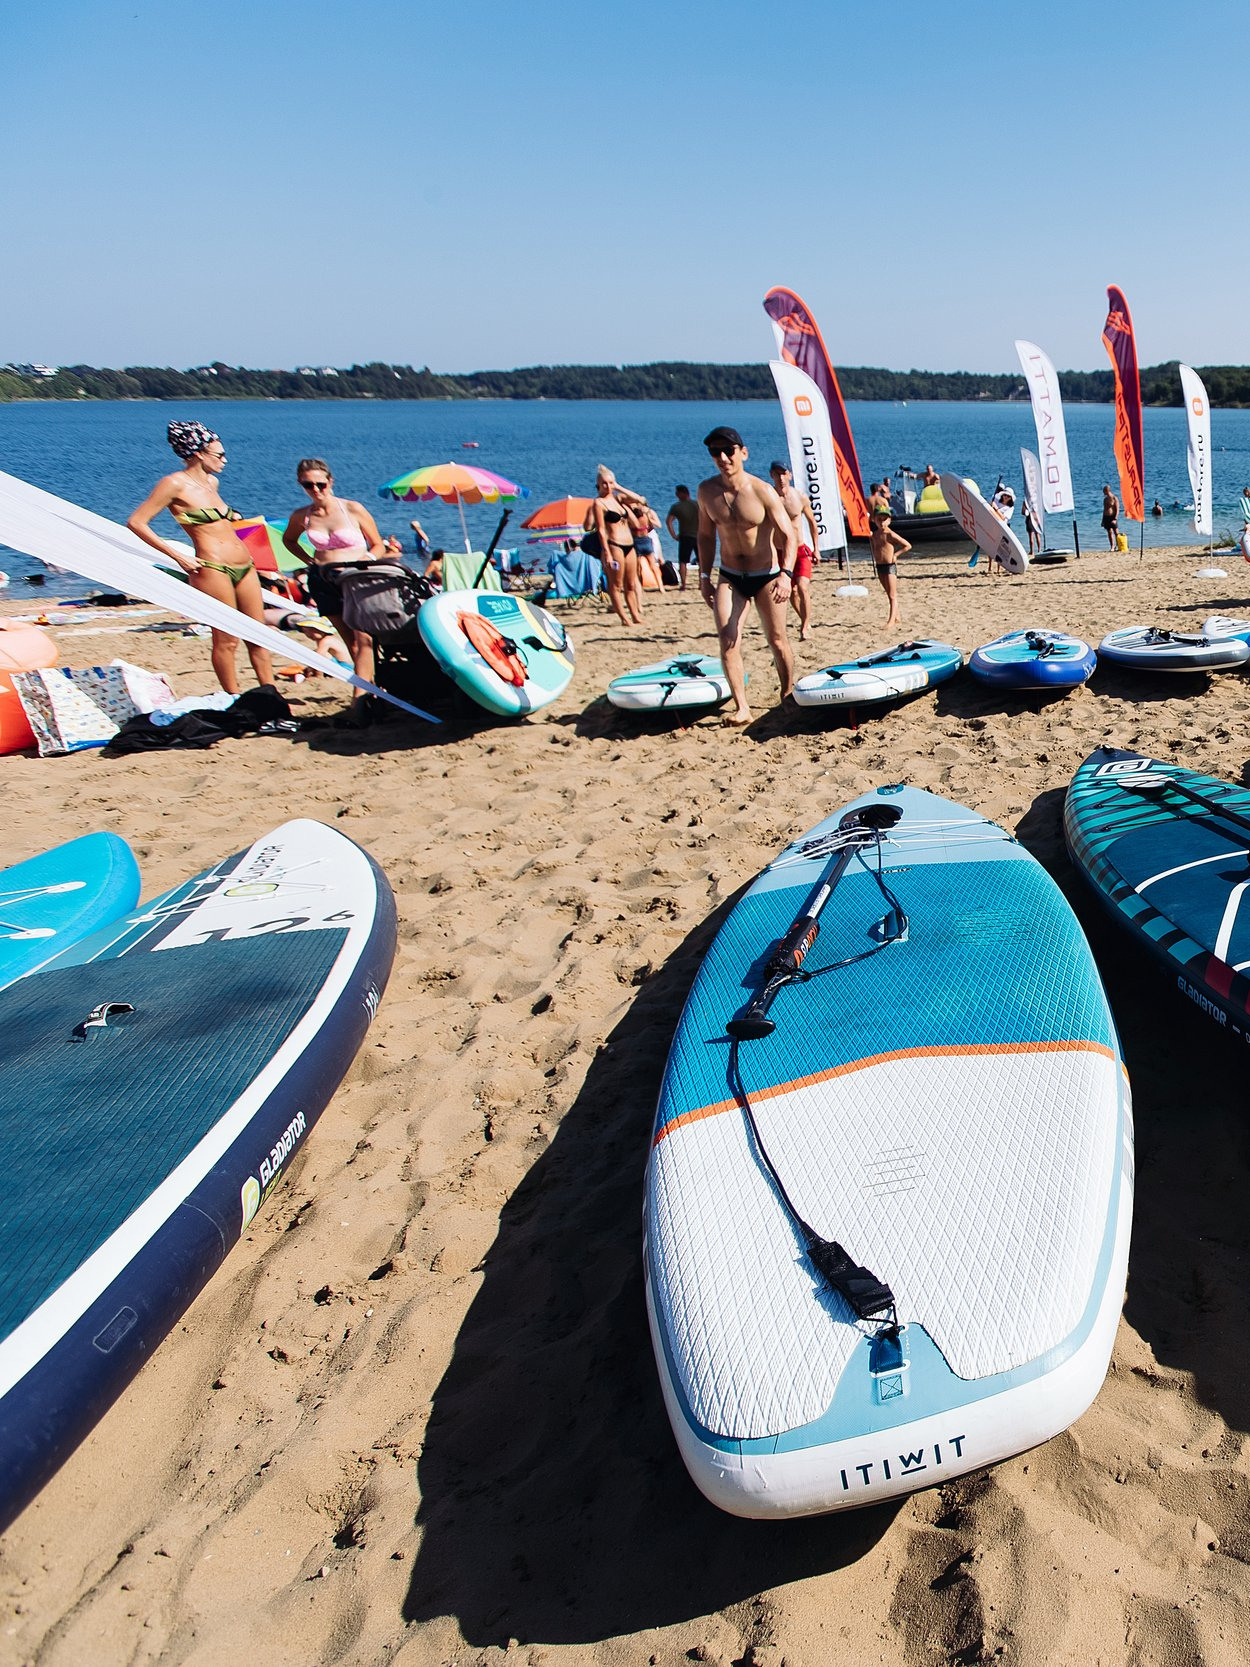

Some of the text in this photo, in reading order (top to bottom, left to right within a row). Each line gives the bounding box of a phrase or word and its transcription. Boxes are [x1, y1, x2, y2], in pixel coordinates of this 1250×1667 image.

[1178, 975, 1227, 1026] GLADIATOR
[259, 1111, 307, 1189] GLADIATOR
[840, 1434, 966, 1491] ITIWIT
